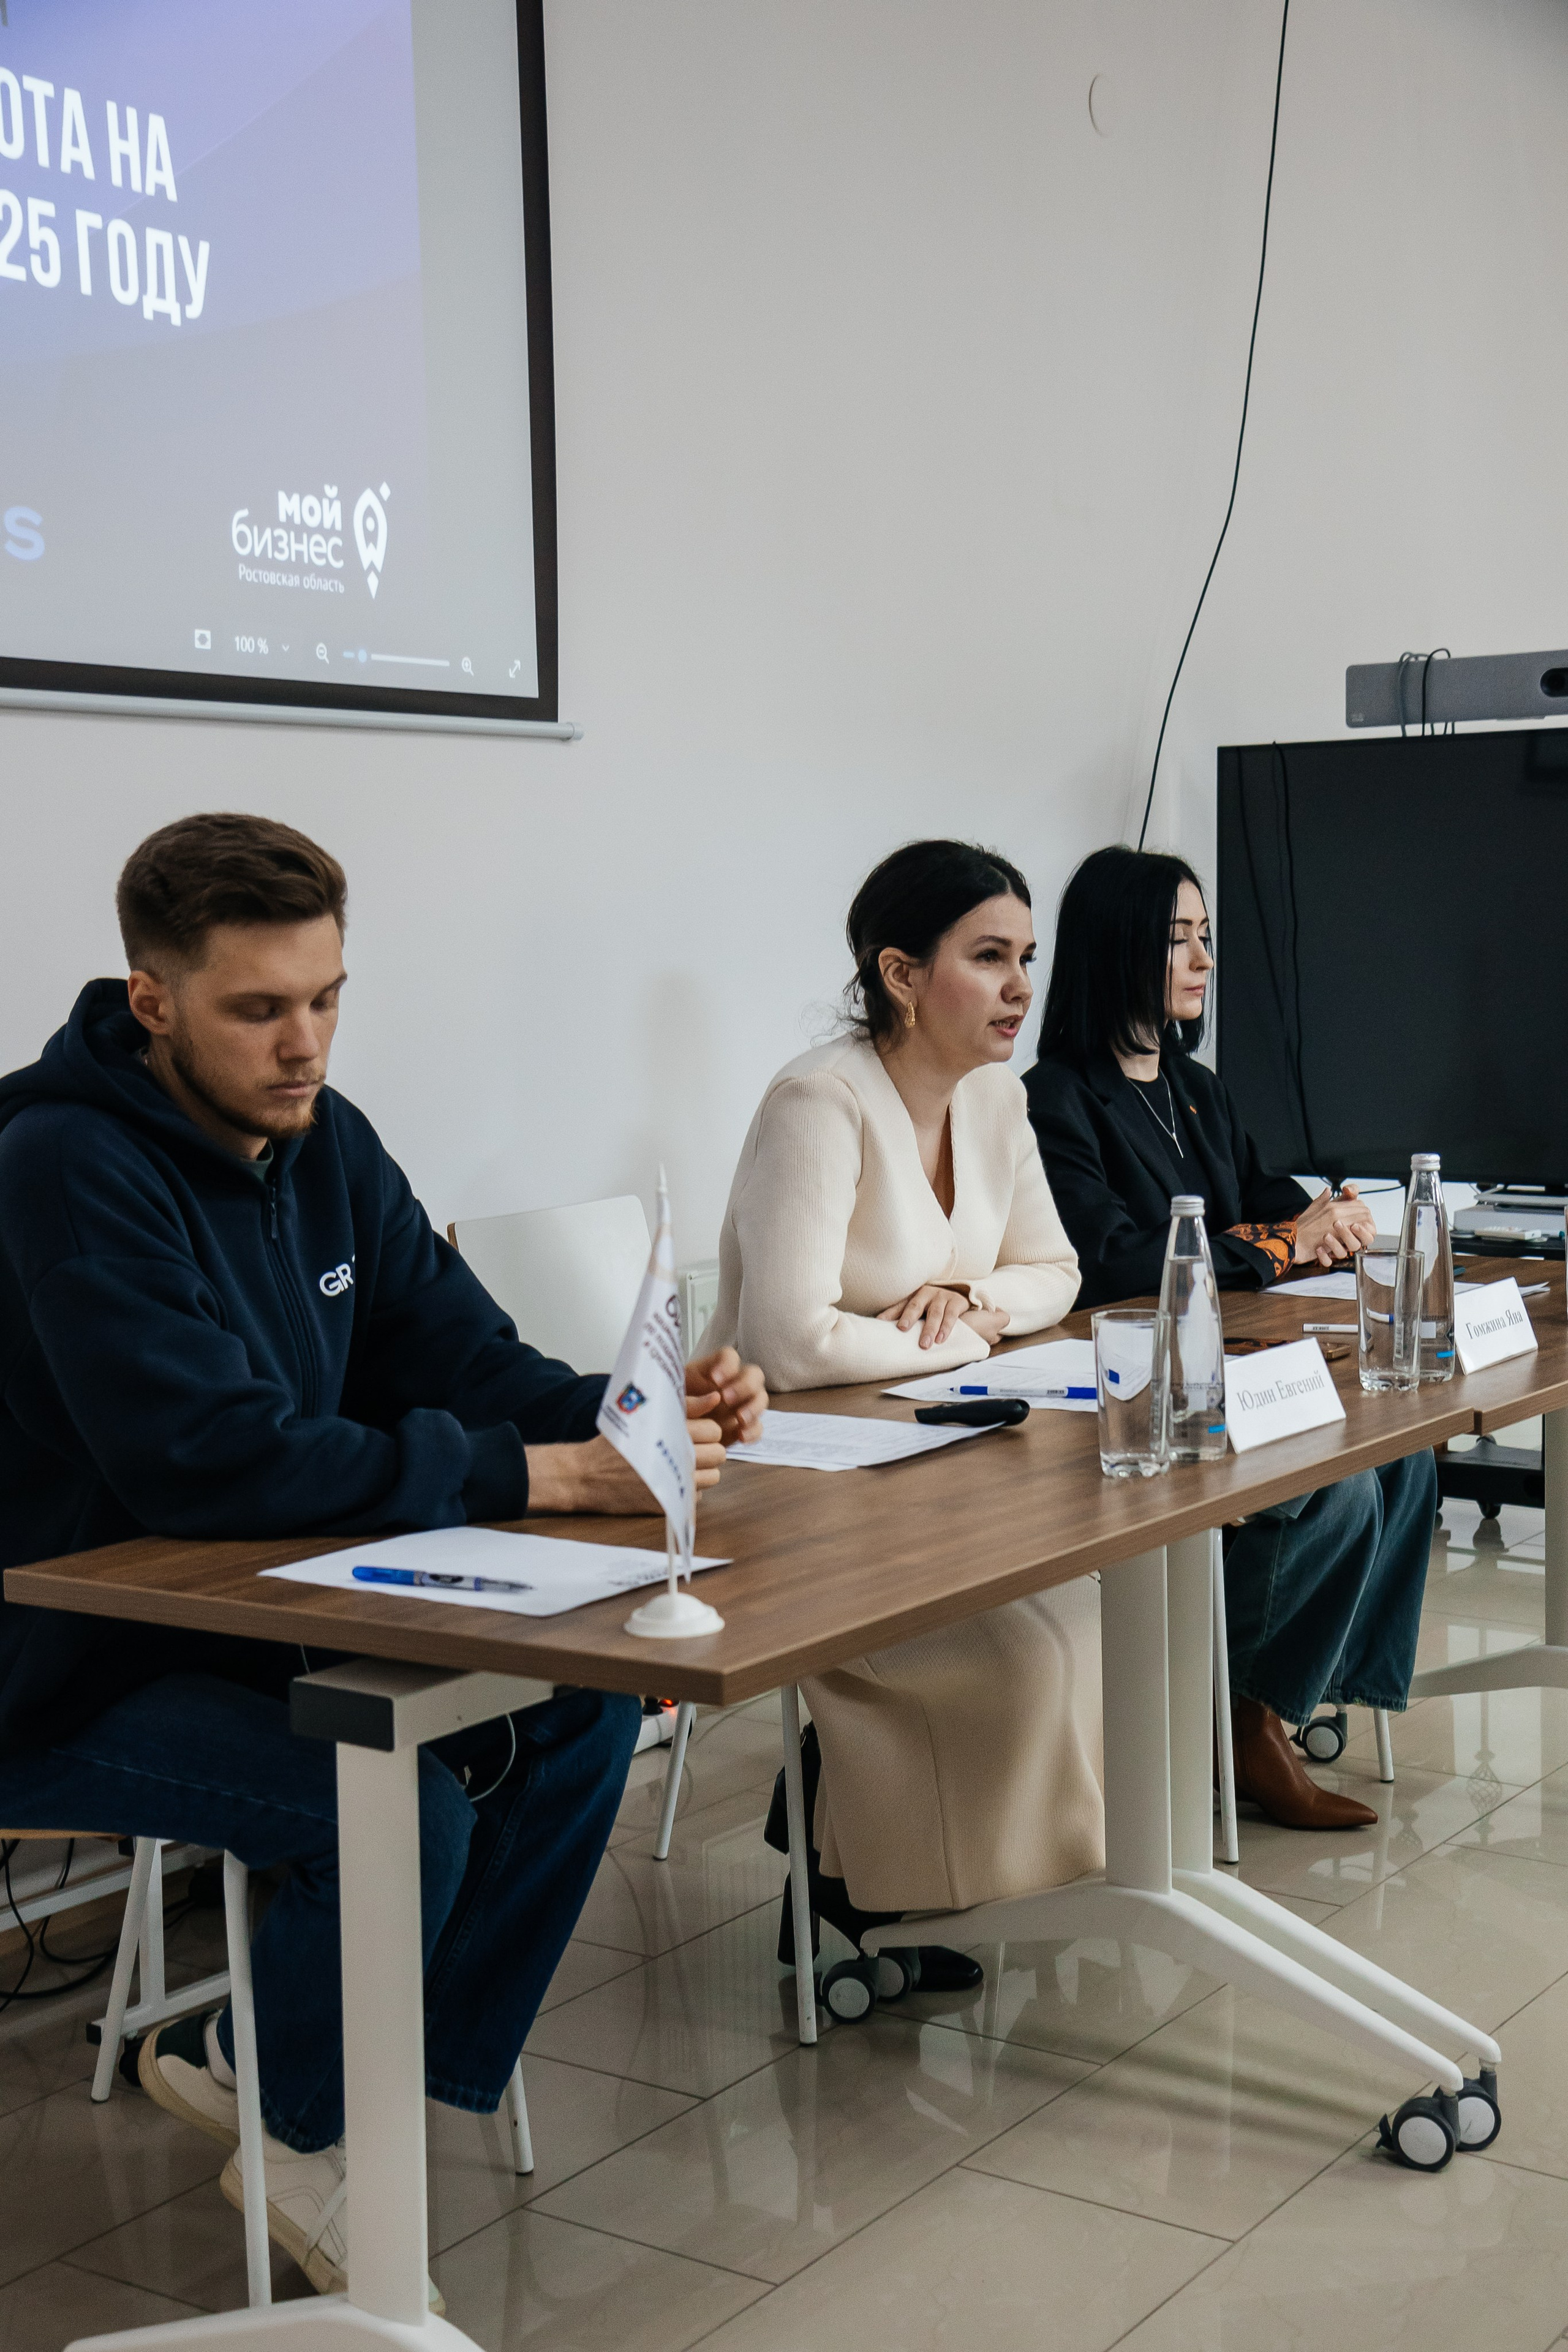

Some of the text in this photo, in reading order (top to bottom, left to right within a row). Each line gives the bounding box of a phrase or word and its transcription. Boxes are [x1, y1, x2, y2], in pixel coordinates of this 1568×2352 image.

[107, 100, 178, 202] НА
[0, 189, 210, 326] 25 ГОДУ
[232, 508, 344, 568] бизнес
[239, 563, 344, 594] Ростовская область
[235, 635, 255, 653] 100
[1466, 1310, 1523, 1340] Гомжина Яна
[1236, 1370, 1325, 1411] Юдин Евгений
